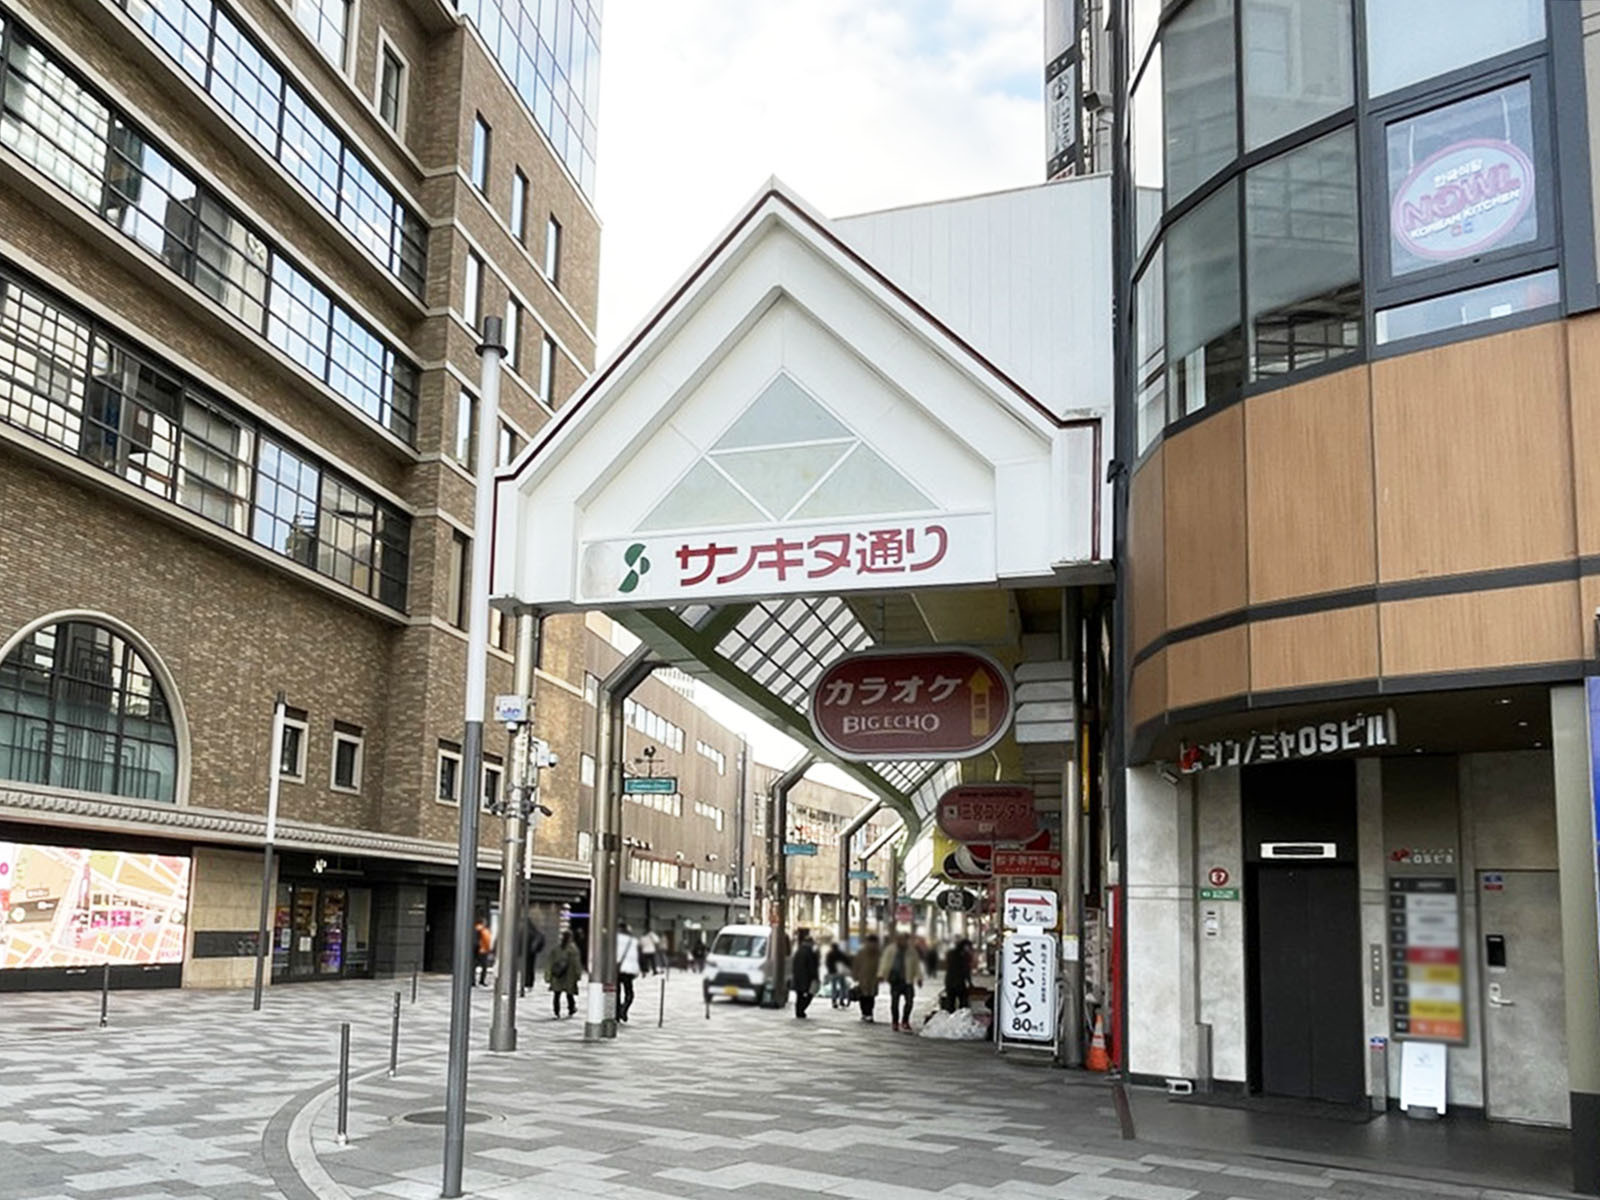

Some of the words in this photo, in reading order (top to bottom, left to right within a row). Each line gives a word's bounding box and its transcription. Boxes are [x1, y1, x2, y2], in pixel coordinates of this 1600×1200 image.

[824, 675, 963, 706] カラオケ
[843, 715, 880, 734] BIG
[883, 713, 940, 733] ECHO
[1008, 906, 1033, 923] すし
[1011, 941, 1035, 1015] 天ぷら
